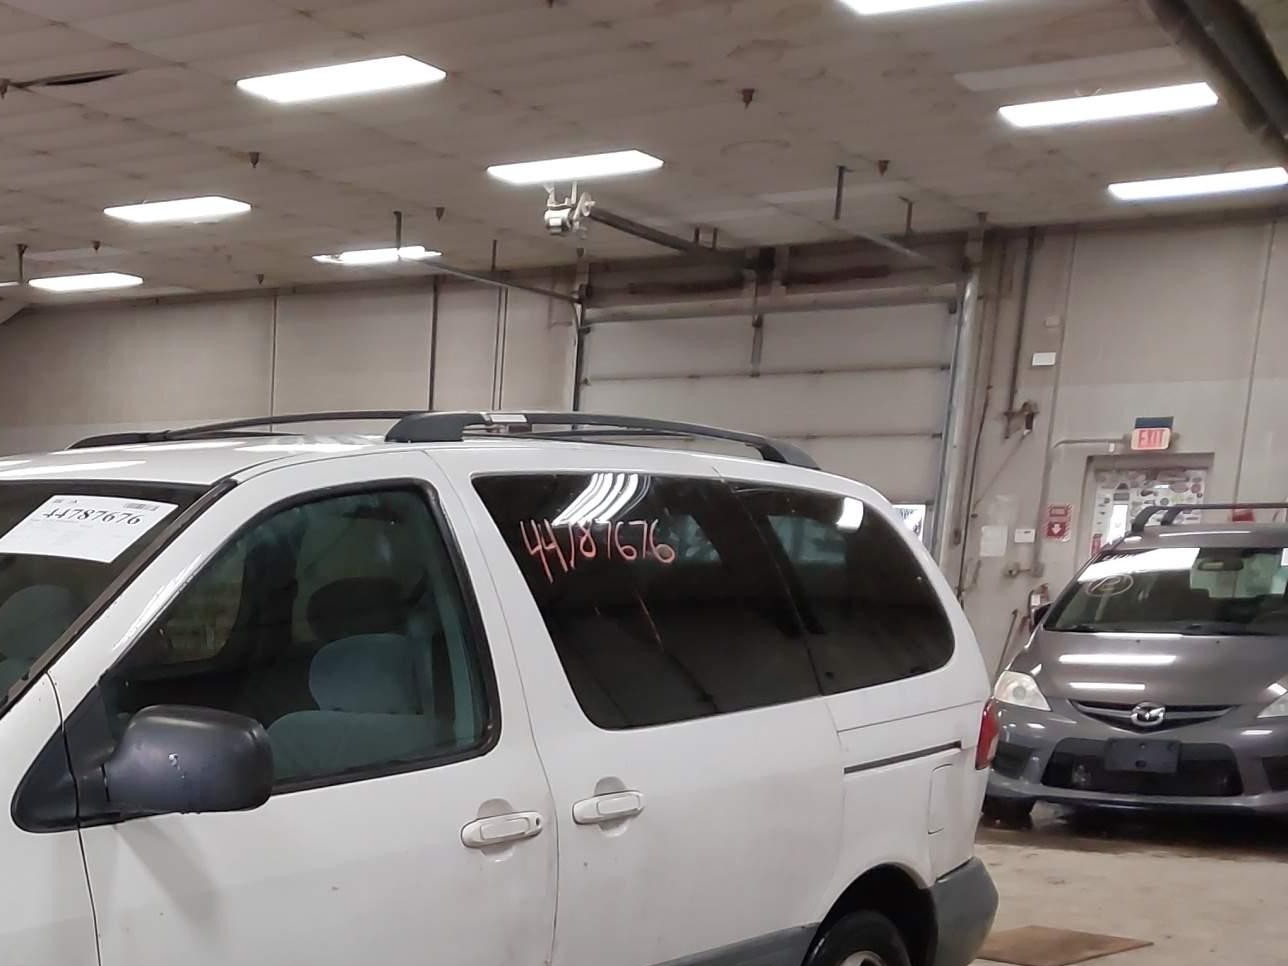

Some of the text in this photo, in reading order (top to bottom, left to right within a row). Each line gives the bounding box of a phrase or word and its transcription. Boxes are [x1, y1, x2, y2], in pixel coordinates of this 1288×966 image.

[1138, 429, 1165, 448] EXIT
[42, 507, 145, 525] 44787676
[520, 518, 676, 584] 44787676
